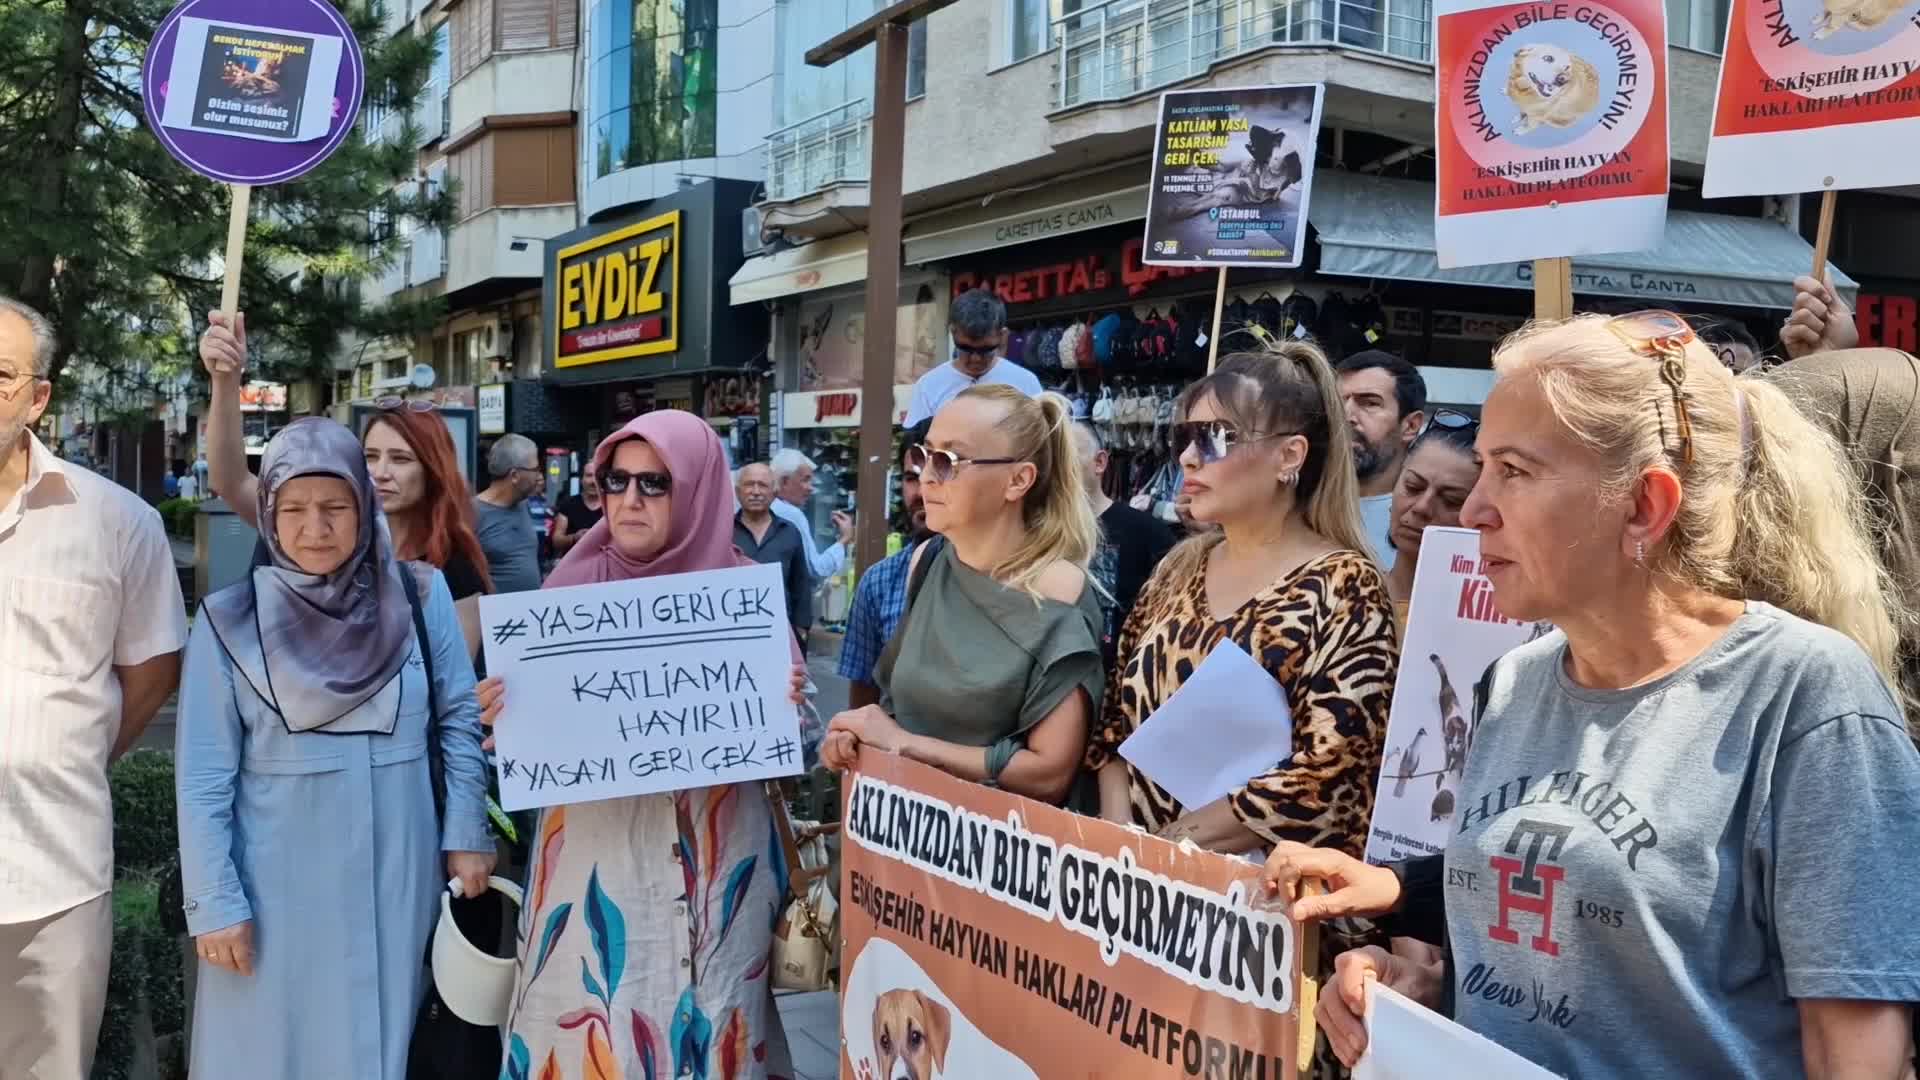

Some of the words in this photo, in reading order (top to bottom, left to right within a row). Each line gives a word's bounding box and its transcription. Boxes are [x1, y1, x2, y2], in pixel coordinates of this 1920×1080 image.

[1463, 23, 1513, 143] AKLINIZDAN
[1514, 4, 1569, 29] BİLE
[1574, 6, 1638, 130] GEÇİRMEYİN!
[207, 98, 242, 112] Bizim
[243, 103, 289, 118] sesimiz
[1744, 97, 1825, 118] HAKLARI
[203, 110, 228, 123] olur
[229, 114, 289, 131] musunuz?
[1168, 117, 1217, 133] KATLİAM
[1220, 118, 1249, 132] YASA
[1166, 135, 1229, 150] TASARISINI
[1164, 150, 1190, 166] GERİ
[1192, 151, 1219, 167] ÇEK!
[1563, 150, 1633, 170] HAYVAN
[1463, 178, 1533, 200] HAKLARI
[1219, 207, 1261, 219] İSTANBUL
[815, 393, 858, 422] JUMP
[1450, 553, 1475, 574] Kim
[652, 586, 716, 625] GERİ
[721, 586, 775, 624] ÇEK
[571, 660, 758, 702] KATLİAMA
[1458, 770, 1658, 872] HILFIGER
[1448, 867, 1479, 892] EST.
[849, 781, 988, 881] AKLINIZDAN
[990, 820, 1053, 911] BİLE
[1058, 852, 1285, 1002] GEÇİRMEYİN!
[1575, 899, 1624, 929] 1985
[849, 870, 925, 942] ESKİŞEHİR
[929, 912, 1008, 980] HAYVAN
[1014, 944, 1108, 1028] HAKLARI
[1462, 962, 1526, 1006] New
[1527, 975, 1577, 1029] York
